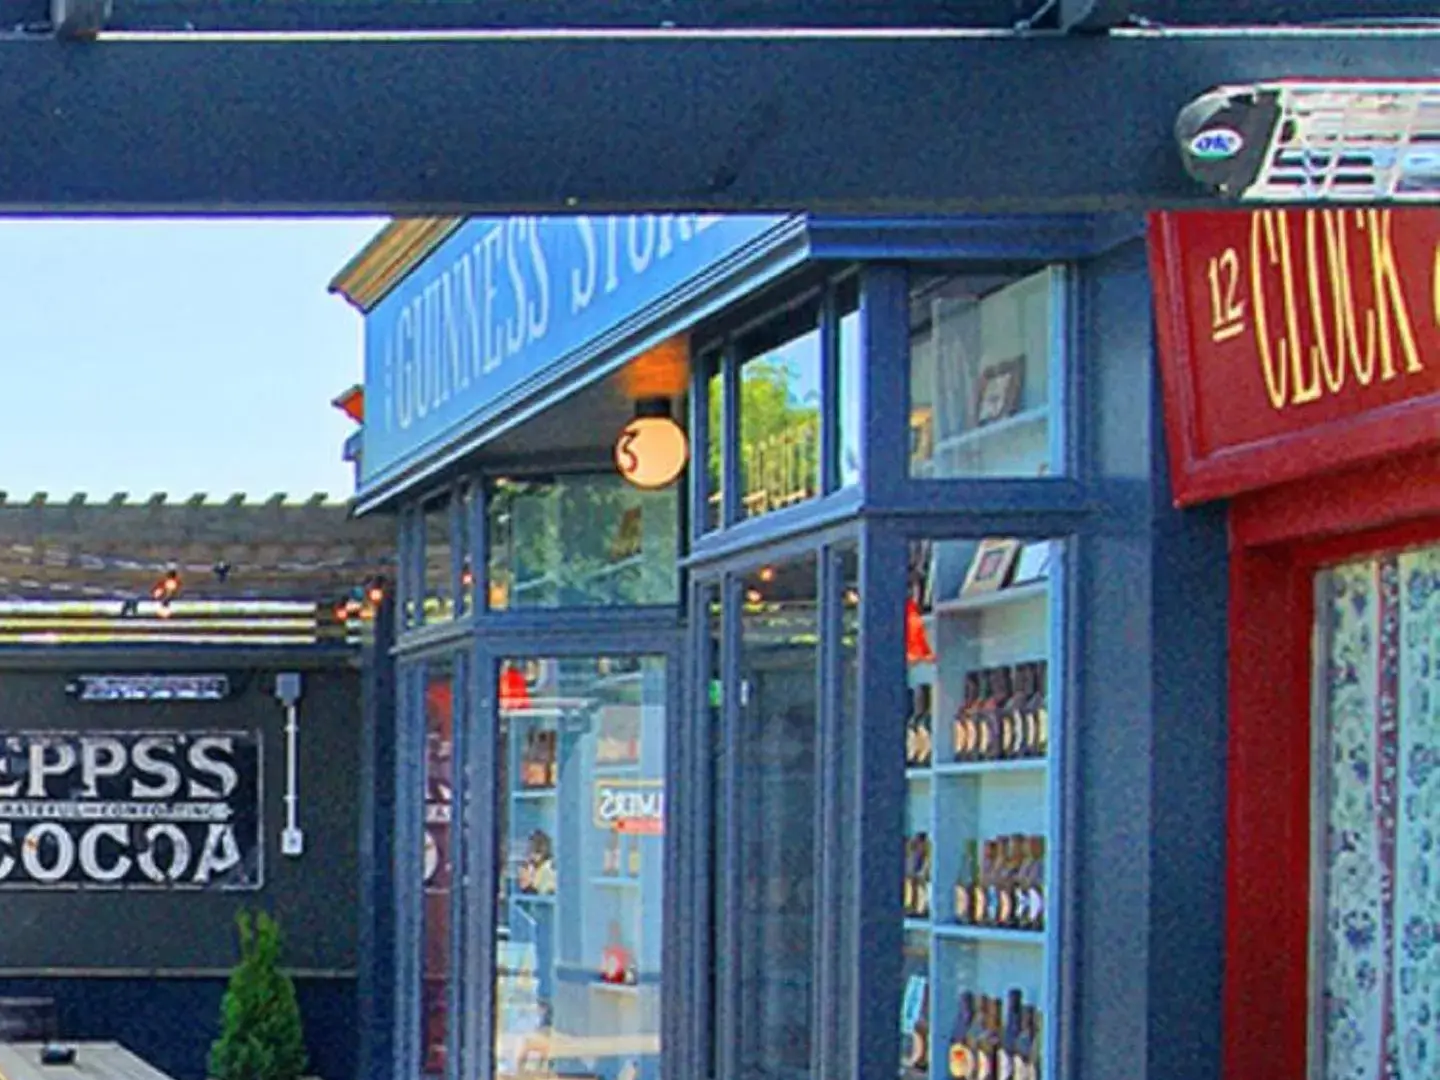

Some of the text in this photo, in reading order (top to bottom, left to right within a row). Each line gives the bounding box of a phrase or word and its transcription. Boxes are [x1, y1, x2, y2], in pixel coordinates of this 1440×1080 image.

[396, 215, 549, 428] GUINNESS
[1209, 247, 1246, 341] 12
[1251, 209, 1424, 409] CLOCK
